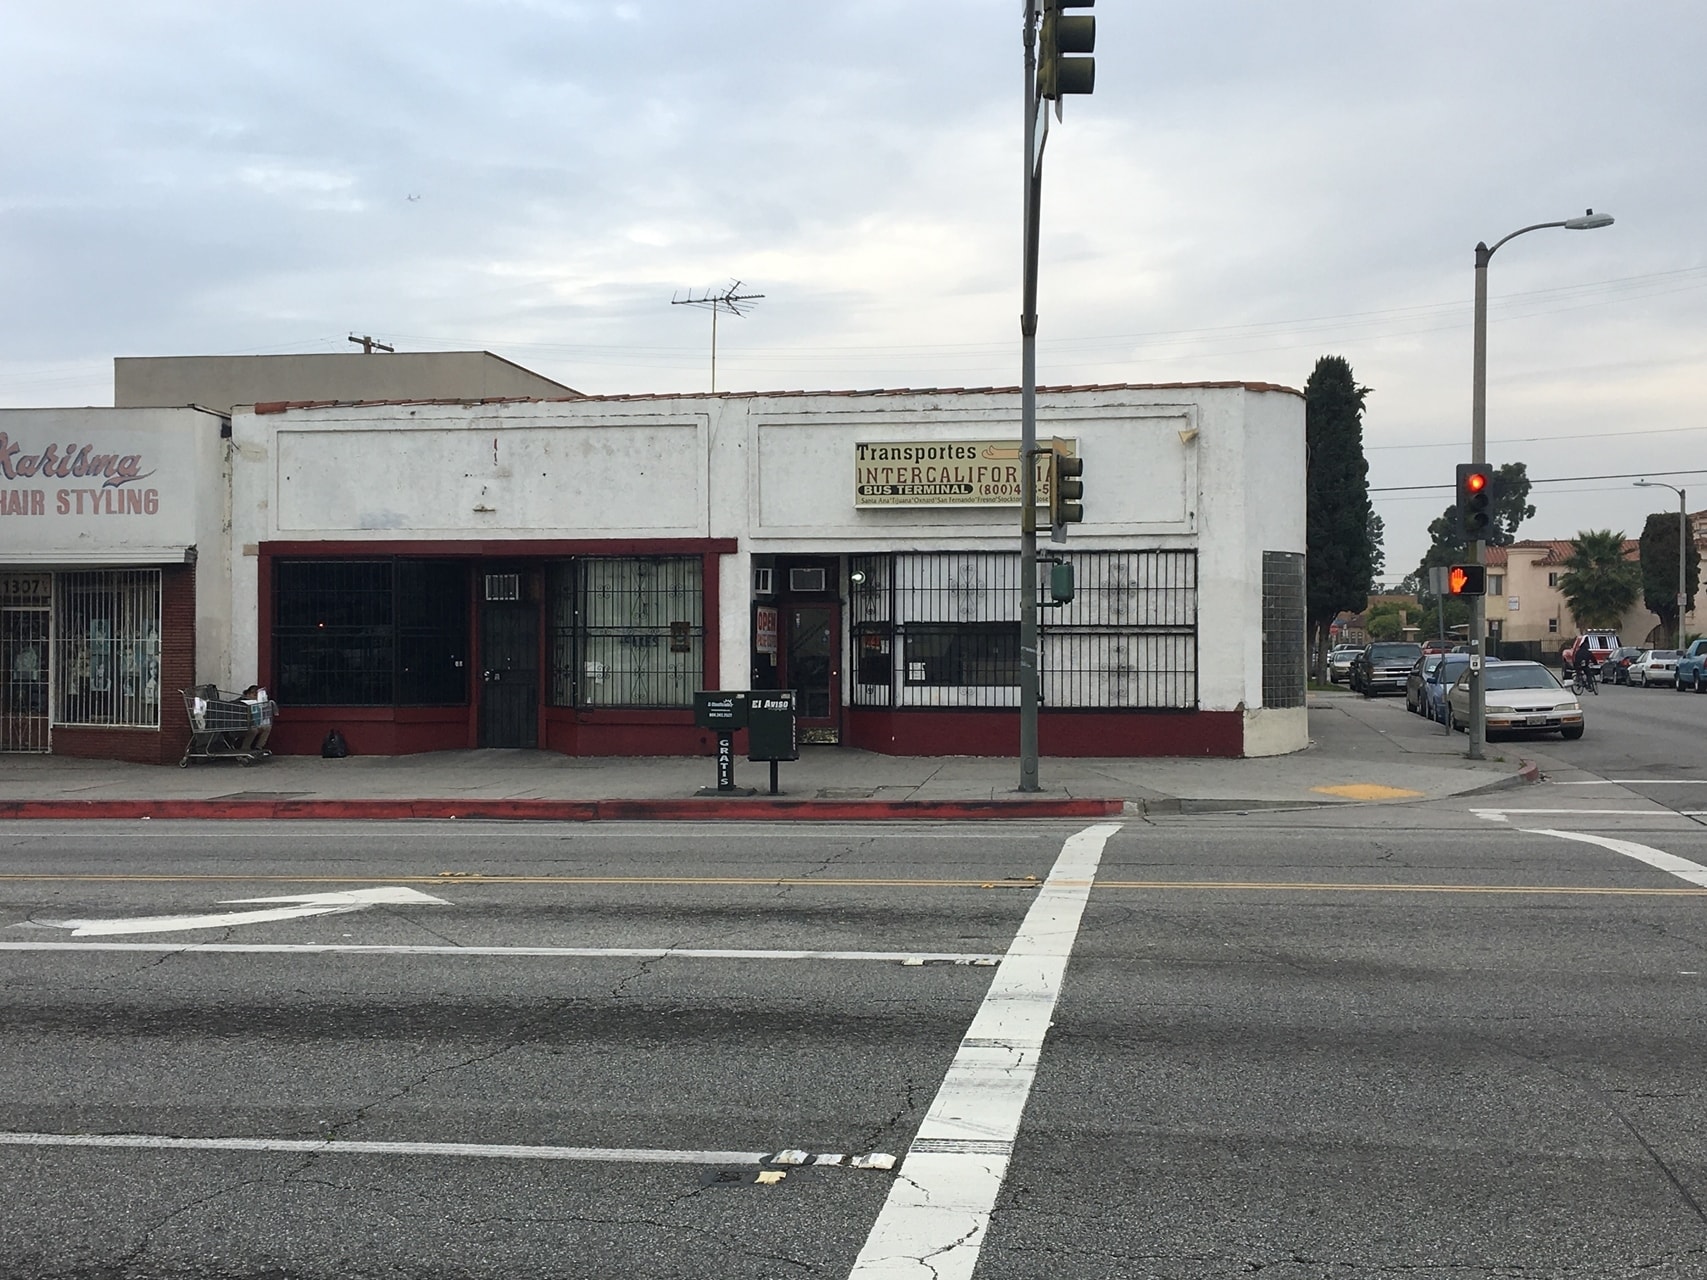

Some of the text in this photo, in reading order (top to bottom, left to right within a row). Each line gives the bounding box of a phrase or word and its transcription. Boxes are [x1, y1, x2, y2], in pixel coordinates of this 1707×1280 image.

[857, 444, 977, 464] Transportes
[858, 466, 1050, 484] INTERCALIFORI
[863, 484, 969, 495] BUS TERMINAL
[56, 488, 159, 515] STYLING
[3, 580, 39, 593] 1307
[758, 611, 776, 631] OPEN
[720, 740, 729, 785] GRATIS
